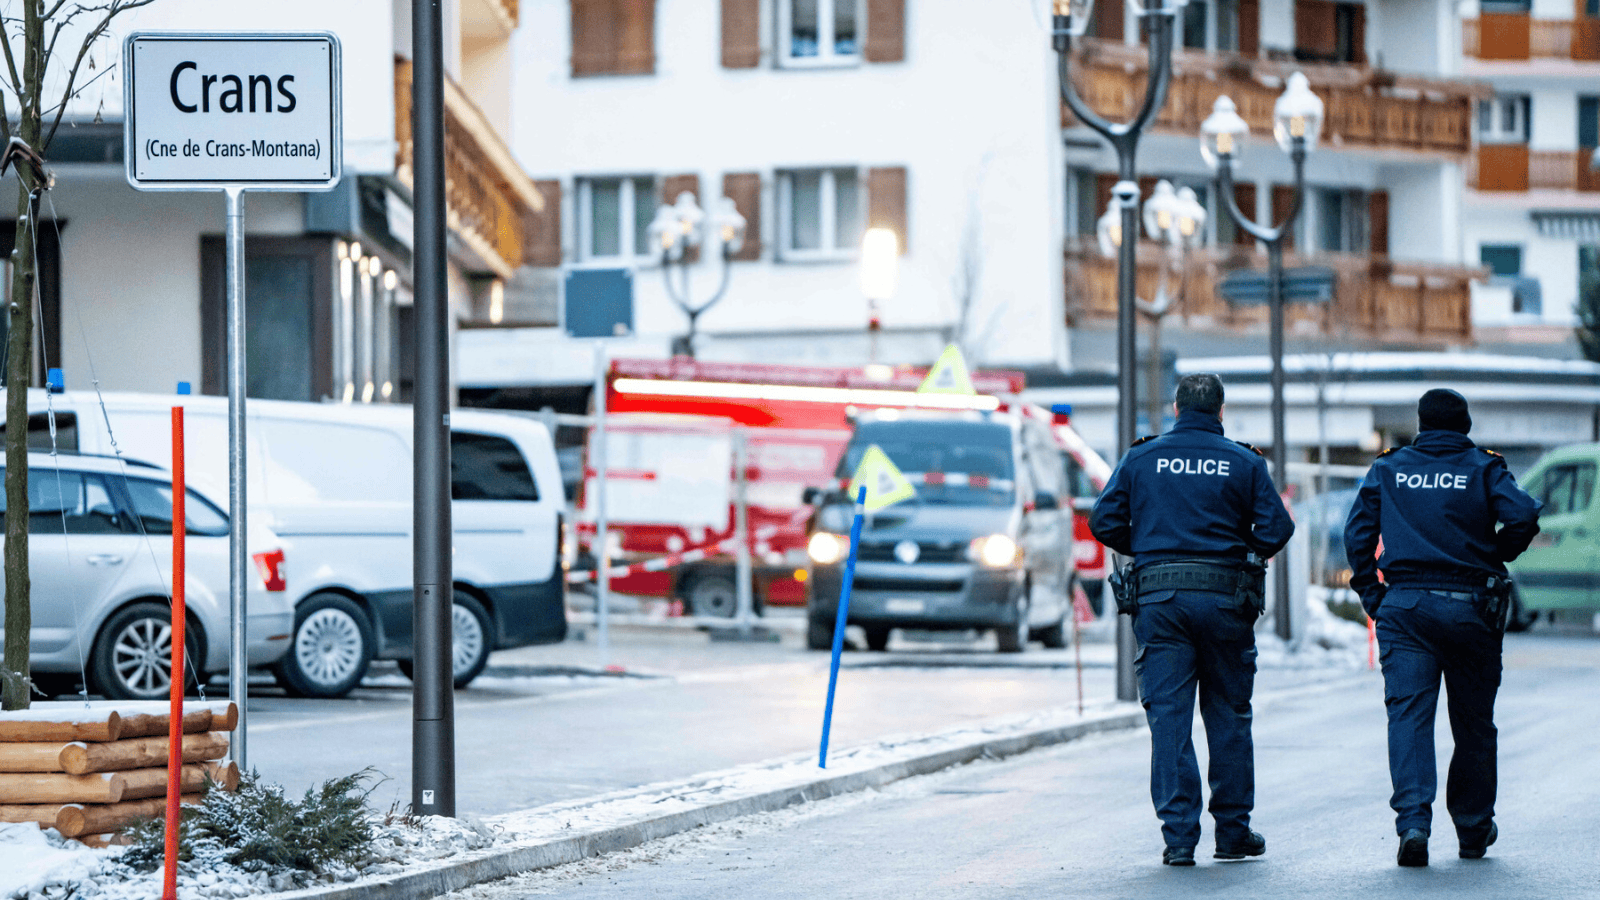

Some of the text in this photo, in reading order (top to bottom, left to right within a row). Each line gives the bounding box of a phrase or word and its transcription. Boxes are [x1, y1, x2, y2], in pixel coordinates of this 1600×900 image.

[169, 60, 297, 114] Crans
[145, 138, 321, 161] (Cne de Crans-Montana)
[1156, 457, 1230, 477] POLICE
[1395, 472, 1468, 490] POLICE
